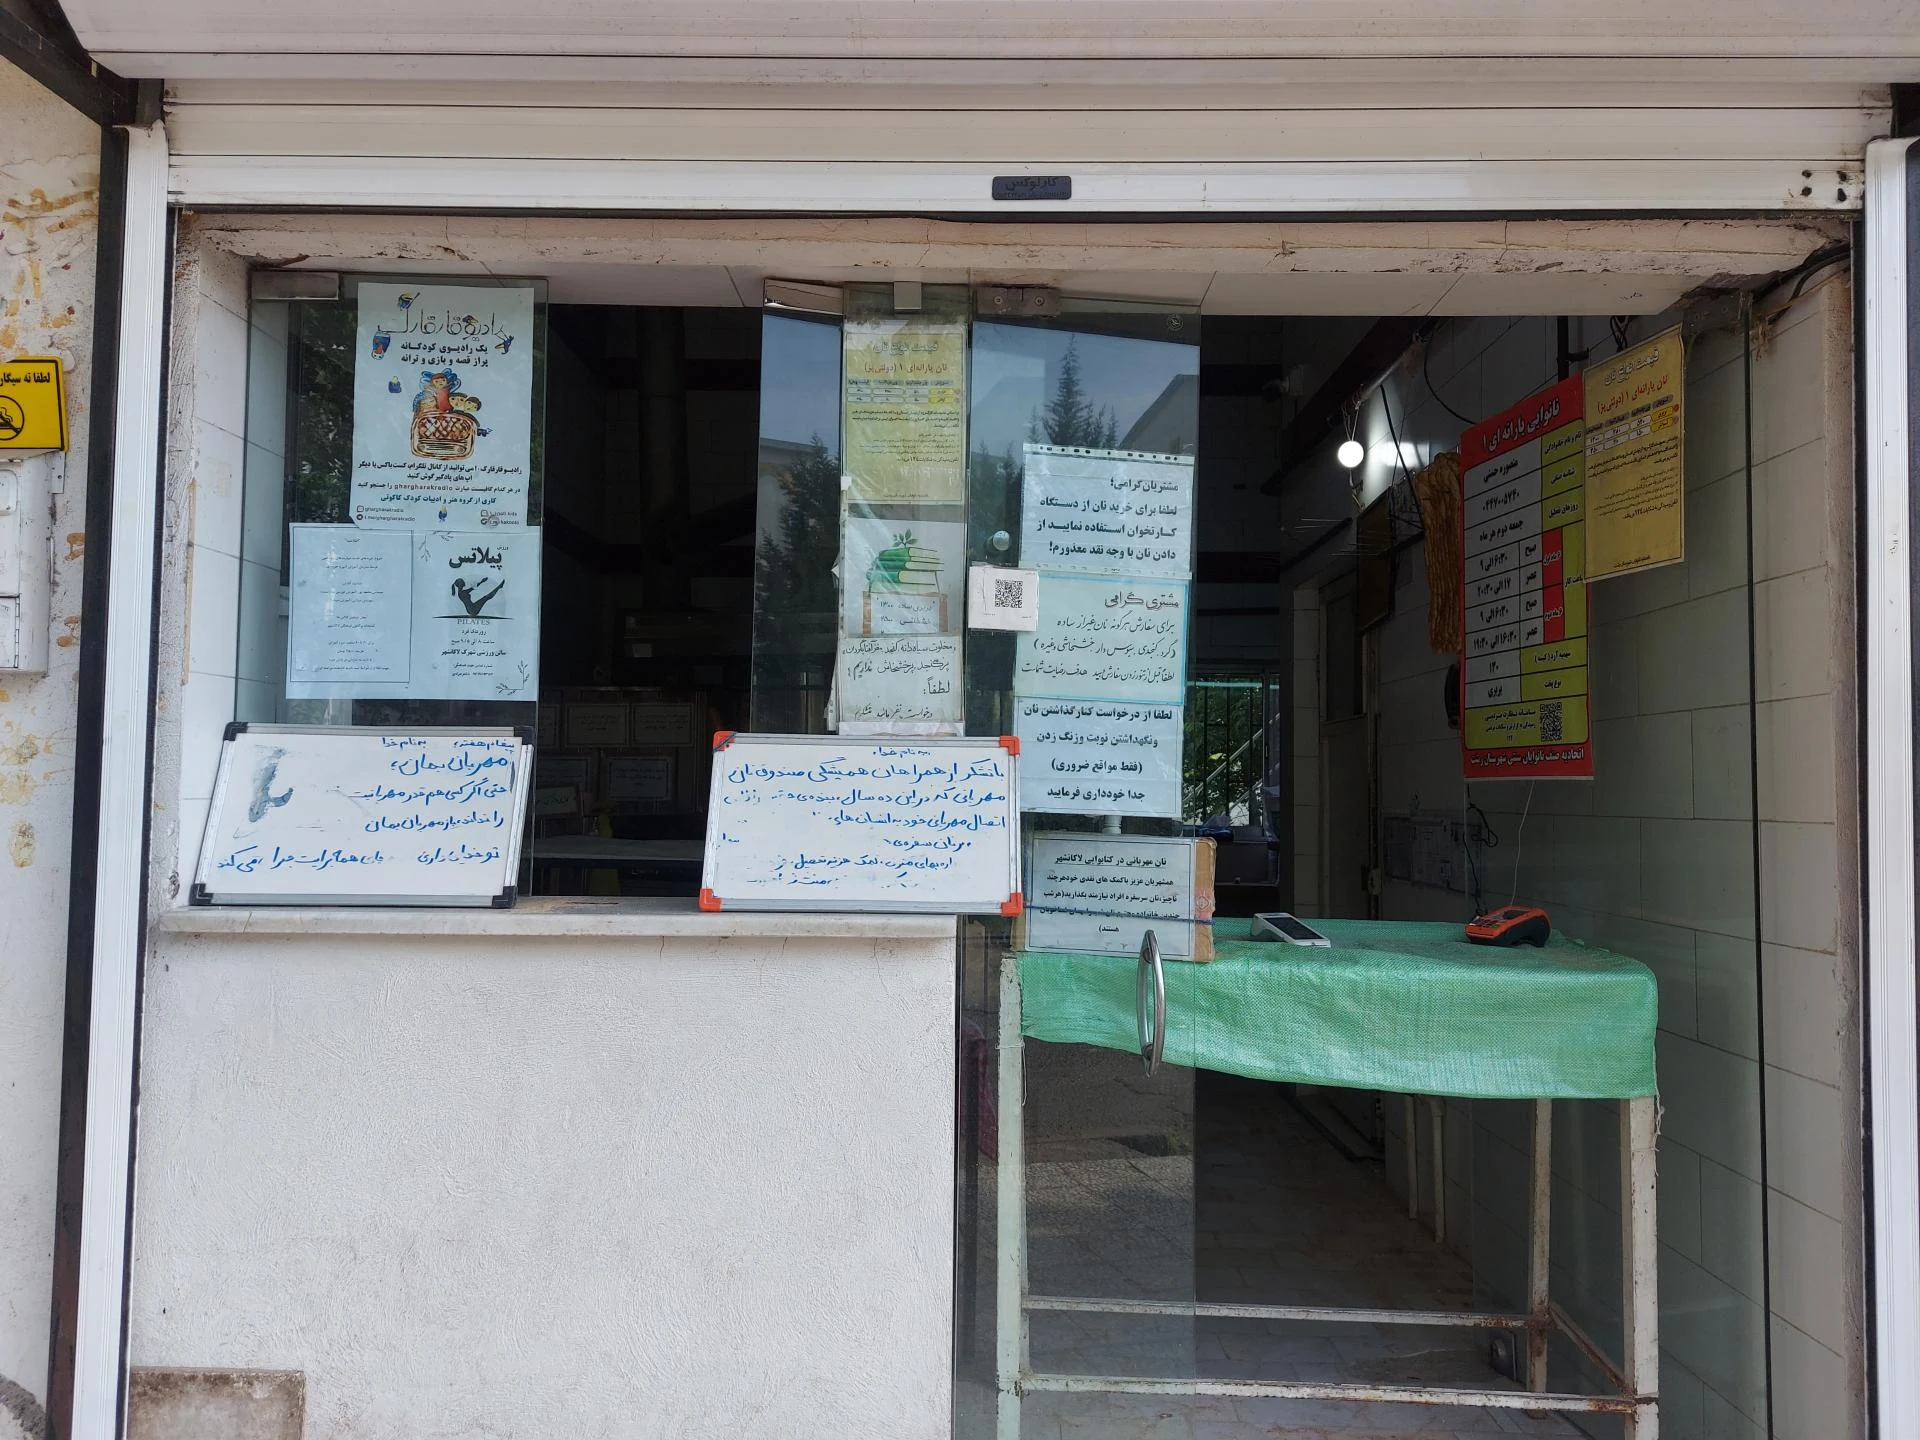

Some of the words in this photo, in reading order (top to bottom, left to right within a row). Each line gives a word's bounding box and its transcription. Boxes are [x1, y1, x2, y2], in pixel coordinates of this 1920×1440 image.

[475, 344, 489, 355] یک
[401, 353, 418, 363] ترانه
[428, 355, 446, 364] بازی
[456, 356, 471, 364] قصه
[24, 373, 31, 383] نه
[33, 372, 50, 383] لطفا
[1528, 398, 1560, 432] نانوایی
[1081, 500, 1090, 512] از
[1092, 500, 1106, 512] نان
[1110, 502, 1132, 514] خرید
[1135, 504, 1156, 516] برای
[1159, 505, 1177, 515] لطفا
[1037, 518, 1046, 532] از
[1084, 523, 1125, 534] استفاده
[1089, 545, 1103, 555] نقد
[1106, 546, 1124, 559] وجه
[1127, 547, 1133, 556] با
[1136, 548, 1150, 560] نان
[1152, 549, 1176, 561] دادن
[449, 546, 503, 570] پیلاتس
[1145, 593, 1179, 610] مشتری
[1157, 619, 1175, 634] برای
[1024, 704, 1039, 716] نان
[1096, 708, 1139, 721] درخواست
[1143, 710, 1151, 721] از
[1154, 710, 1172, 719] لطفا
[1037, 731, 1056, 743] زدن
[1086, 733, 1108, 745] نوبت
[1092, 759, 1117, 773] مواقع
[1083, 788, 1125, 801] خودداری
[1128, 790, 1145, 802] جدا
[1116, 856, 1124, 866] در
[1126, 857, 1153, 866] مهربانی
[1154, 857, 1166, 867] نان
